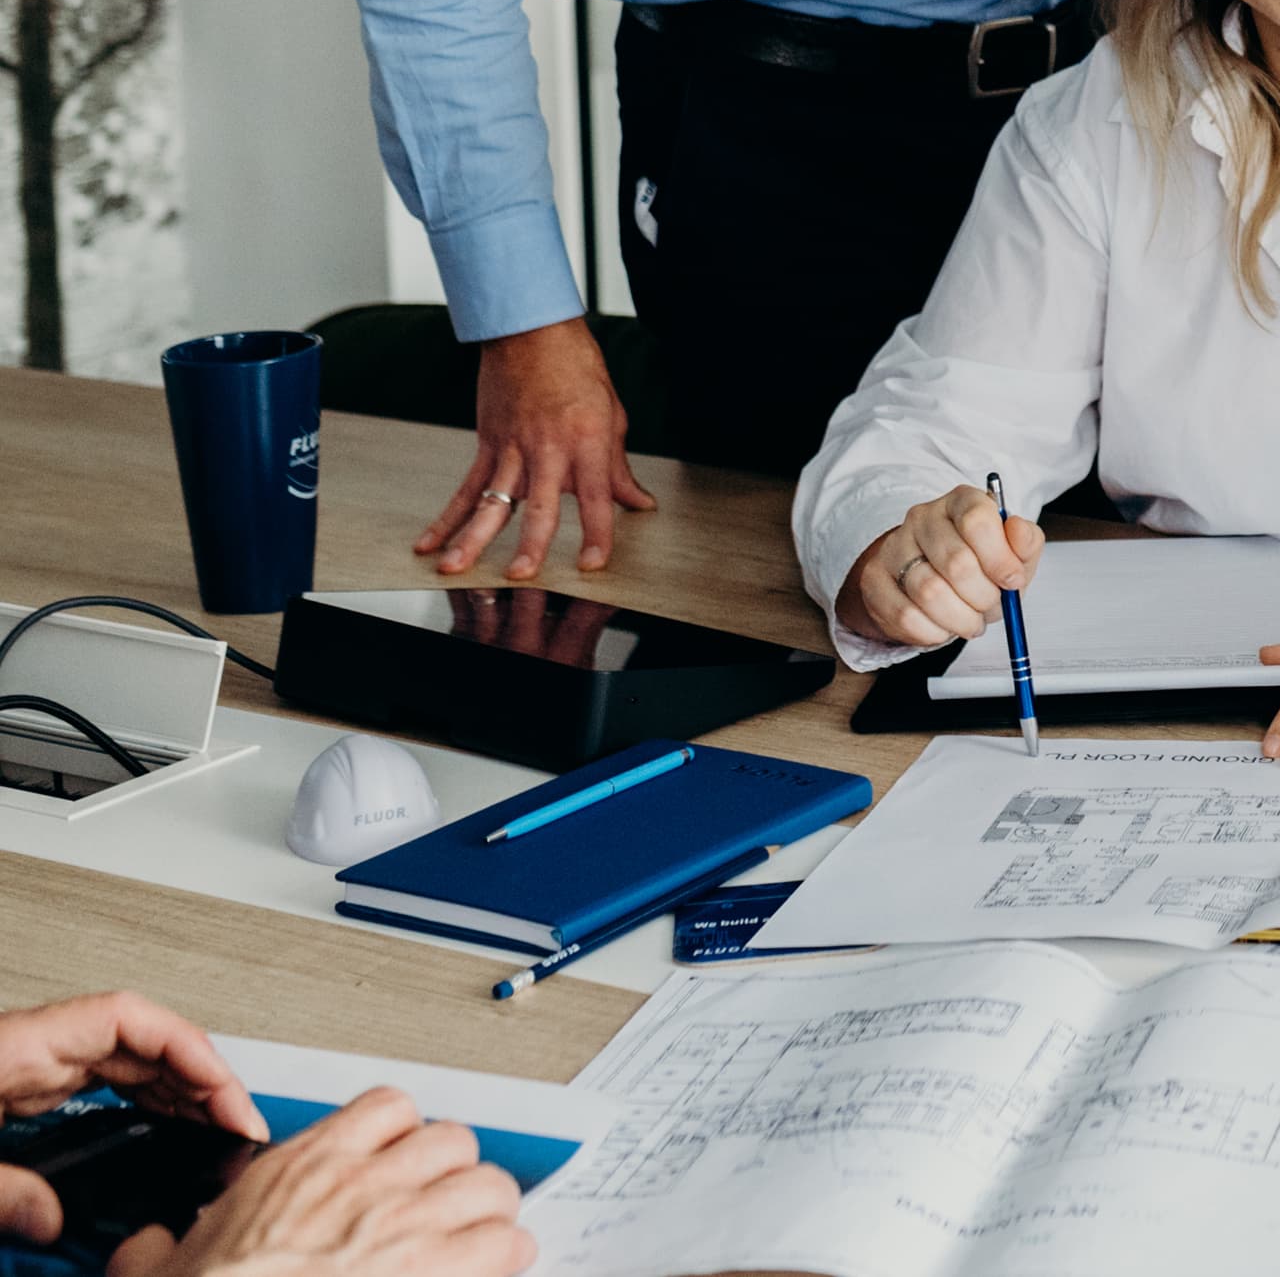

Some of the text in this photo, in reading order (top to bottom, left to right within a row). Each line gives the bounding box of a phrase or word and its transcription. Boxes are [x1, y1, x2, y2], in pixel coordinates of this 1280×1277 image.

[1083, 752, 1165, 762] FLOOR
[1171, 753, 1275, 764] GROUND
[694, 921, 718, 930] We
[720, 916, 759, 927] build
